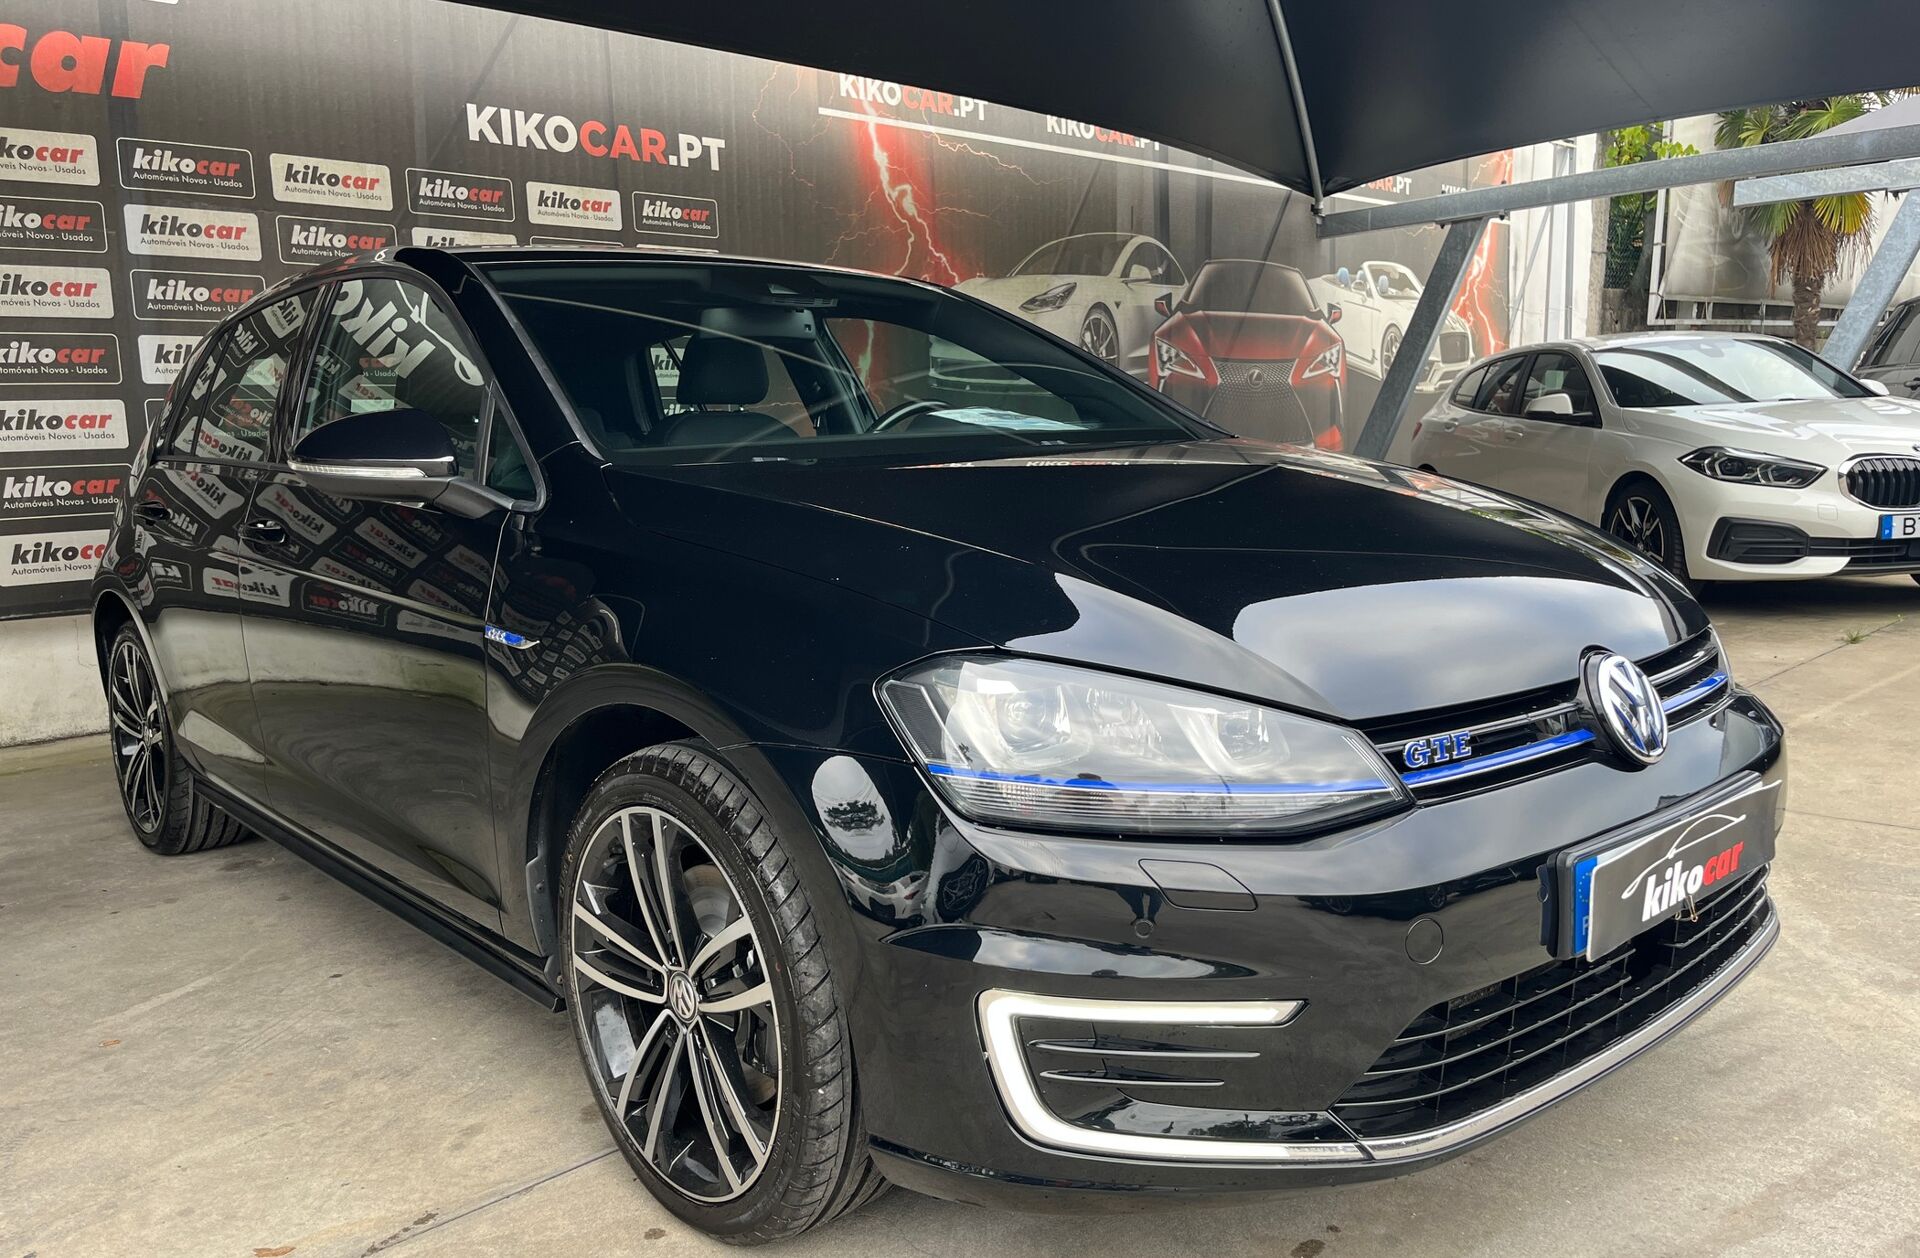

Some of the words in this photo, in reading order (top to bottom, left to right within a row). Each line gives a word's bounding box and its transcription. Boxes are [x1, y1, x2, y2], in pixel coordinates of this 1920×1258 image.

[839, 73, 988, 121] KIKOCAR.PT
[466, 103, 726, 171] KIKOCAR.PT
[19, 163, 48, 172] Novos
[55, 165, 87, 175] Usados
[132, 148, 241, 177] kikocar
[133, 171, 180, 183] Automóveis
[182, 175, 208, 185] Novos
[213, 178, 243, 188] Usados
[284, 163, 380, 191] kikocar
[418, 177, 504, 203] kikocar
[537, 190, 612, 213] kikocar
[642, 199, 711, 222] kikocar
[26, 230, 55, 240] Novos
[61, 232, 94, 242] Usados
[140, 213, 247, 240] kikocar
[290, 224, 386, 251] kikocar
[140, 237, 187, 248] Automóveis
[189, 240, 215, 249] Novos
[220, 242, 250, 251] Usados
[146, 278, 254, 304] kikocar
[33, 299, 61, 308] Novos
[68, 299, 101, 308] Usados
[147, 302, 194, 312] Automóveis
[196, 303, 222, 313] Novos
[41, 365, 69, 374] Novos
[76, 365, 108, 374] Usados
[48, 432, 77, 440] Novos
[83, 430, 116, 439] Usados
[3, 475, 121, 499] kikocar
[3, 499, 54, 509] Automóveis
[56, 497, 85, 506] Novos
[91, 495, 120, 505] Usado
[1903, 516, 1920, 535] B
[11, 565, 62, 576] Automóveis
[64, 563, 92, 572] Novos
[1403, 730, 1472, 769] GTE
[1641, 841, 1745, 923] kikocar
